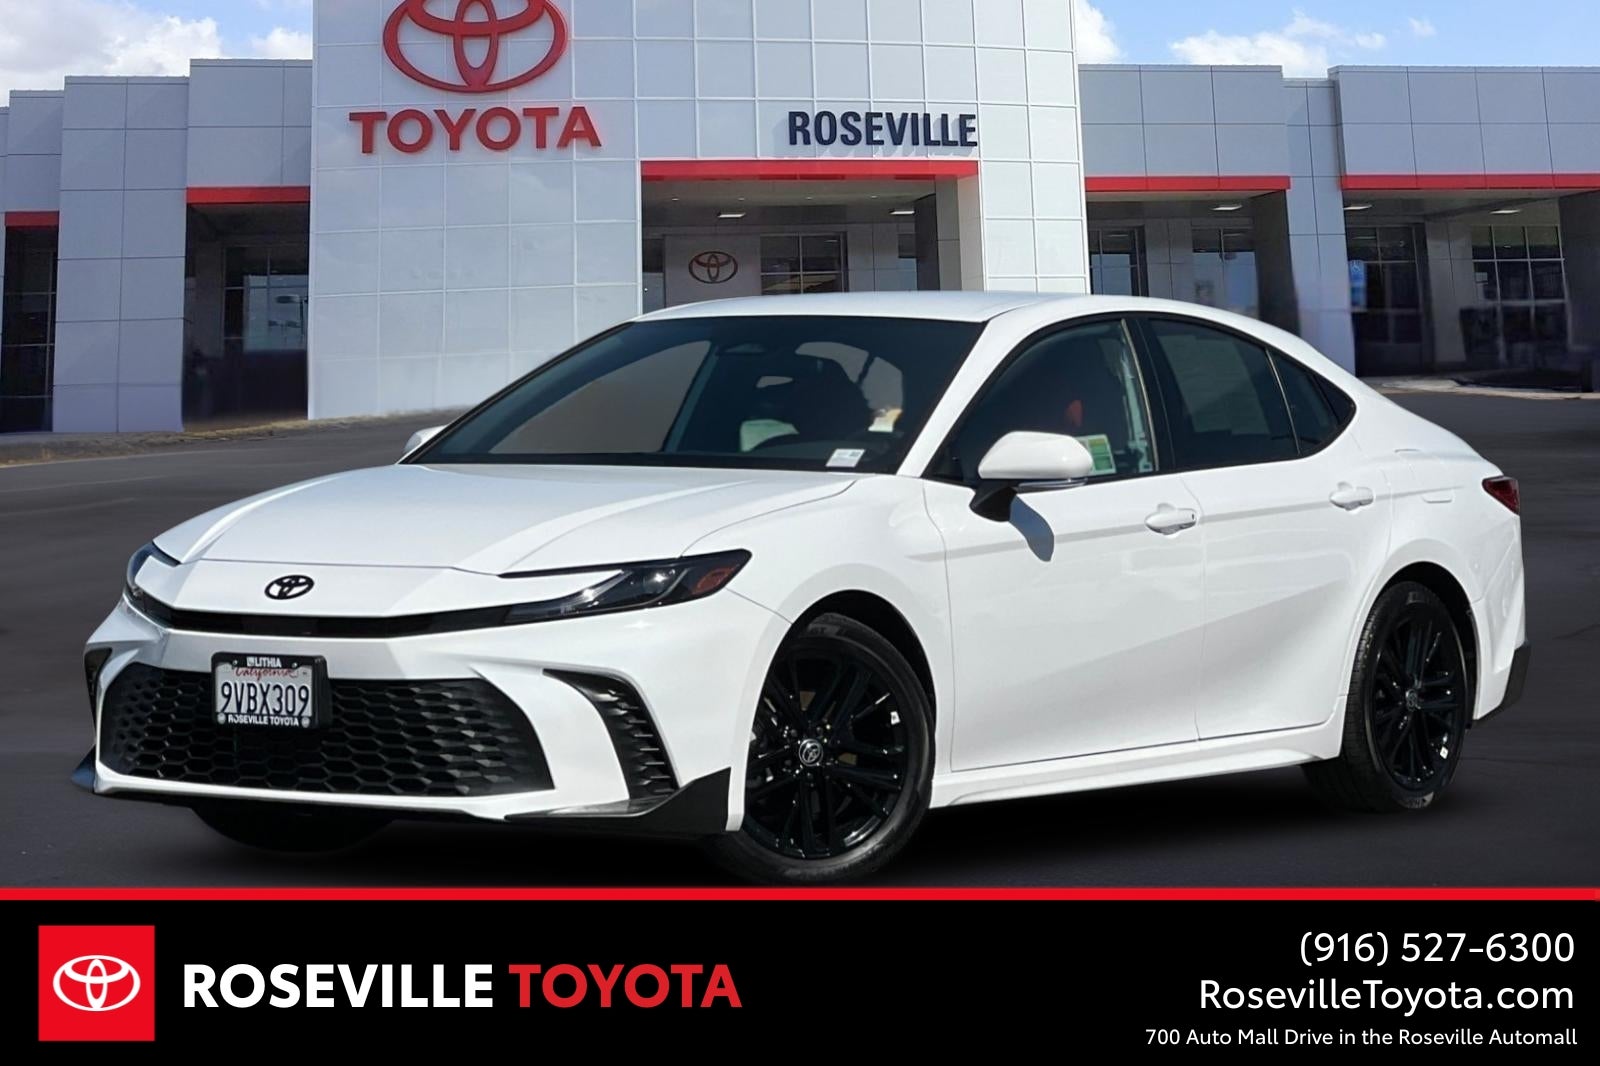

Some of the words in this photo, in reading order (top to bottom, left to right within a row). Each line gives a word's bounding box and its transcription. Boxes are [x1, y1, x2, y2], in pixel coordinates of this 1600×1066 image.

[349, 106, 600, 154] TOYOTA
[788, 110, 979, 147] ROSEVILLE
[254, 657, 282, 668] LITHIA
[221, 681, 310, 716] 9VBX309
[228, 714, 268, 725] ROSEVILLE
[270, 716, 299, 726] TOYOTA
